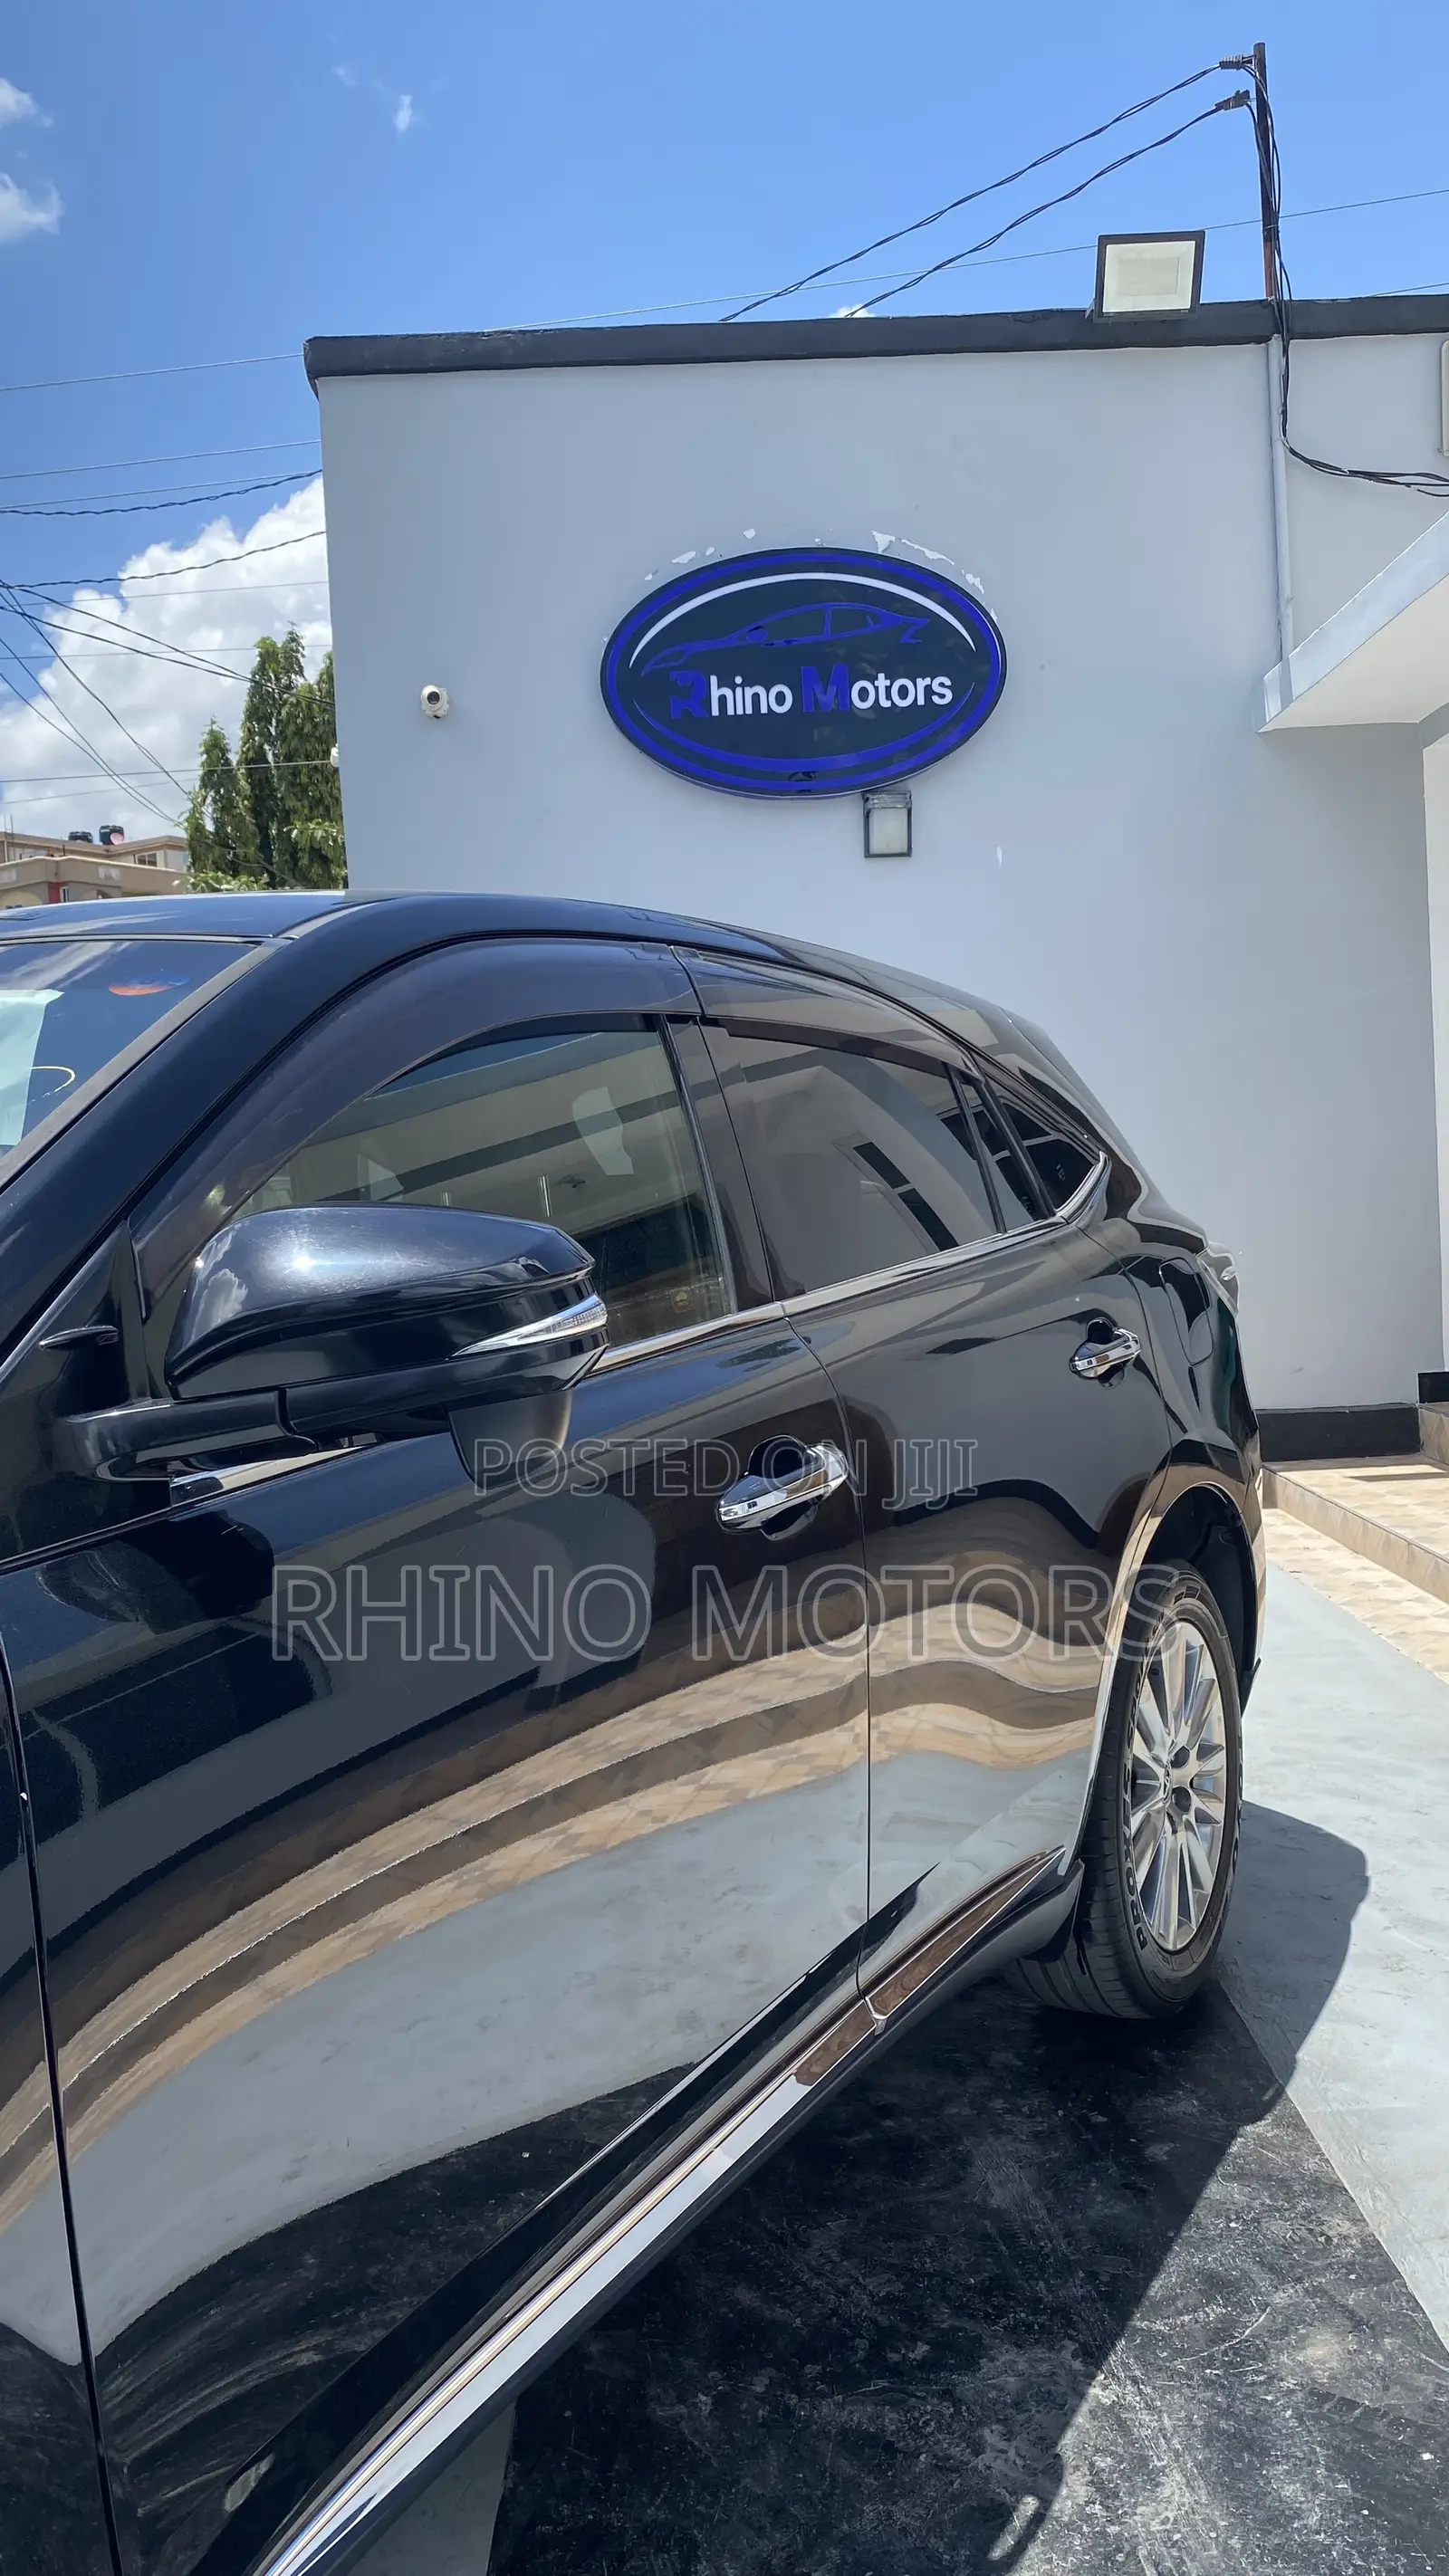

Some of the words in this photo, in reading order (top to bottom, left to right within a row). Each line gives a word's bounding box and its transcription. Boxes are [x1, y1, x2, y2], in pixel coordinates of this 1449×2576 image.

[669, 670, 793, 719] Rhino
[801, 664, 954, 712] Motors
[1123, 1762, 1147, 1950] PROXES
